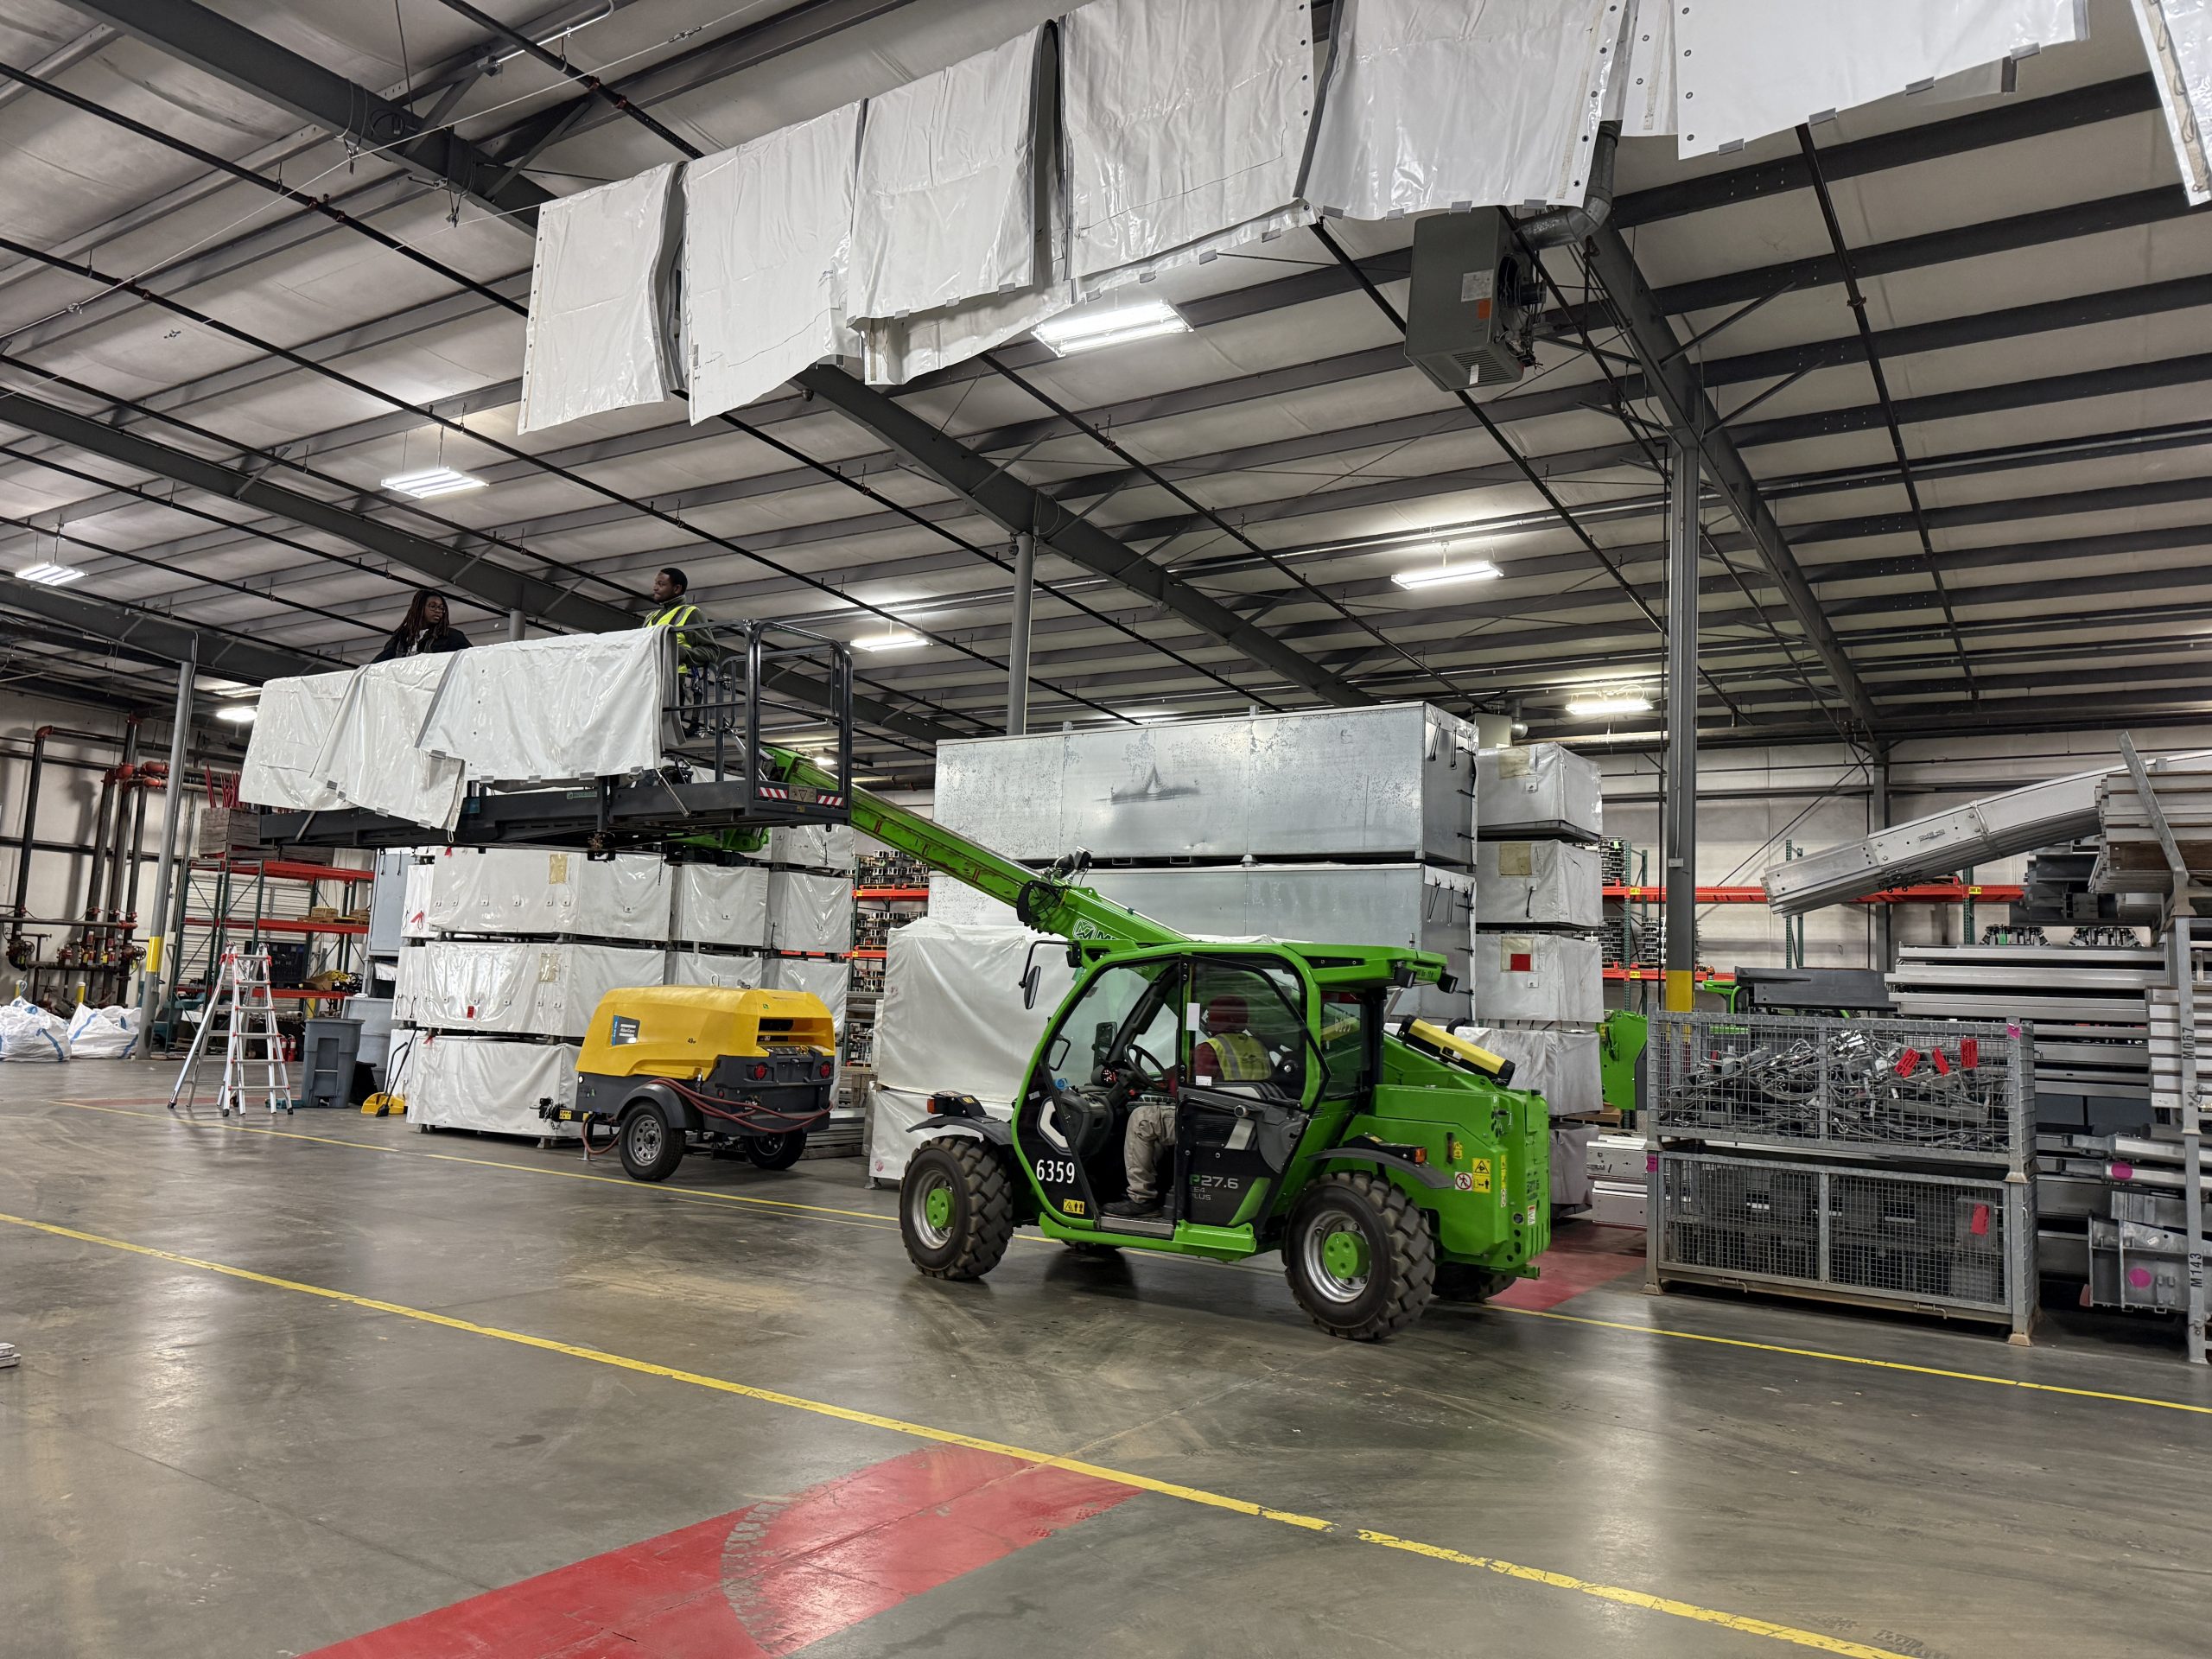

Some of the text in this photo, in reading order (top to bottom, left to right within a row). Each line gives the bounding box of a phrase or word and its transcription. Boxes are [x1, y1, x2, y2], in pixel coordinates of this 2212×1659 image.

[2182, 1027, 2196, 1059] M067
[1036, 1159, 1076, 1184] 6359
[1189, 1174, 1239, 1189] P27.6
[2190, 1253, 2203, 1288] M143
